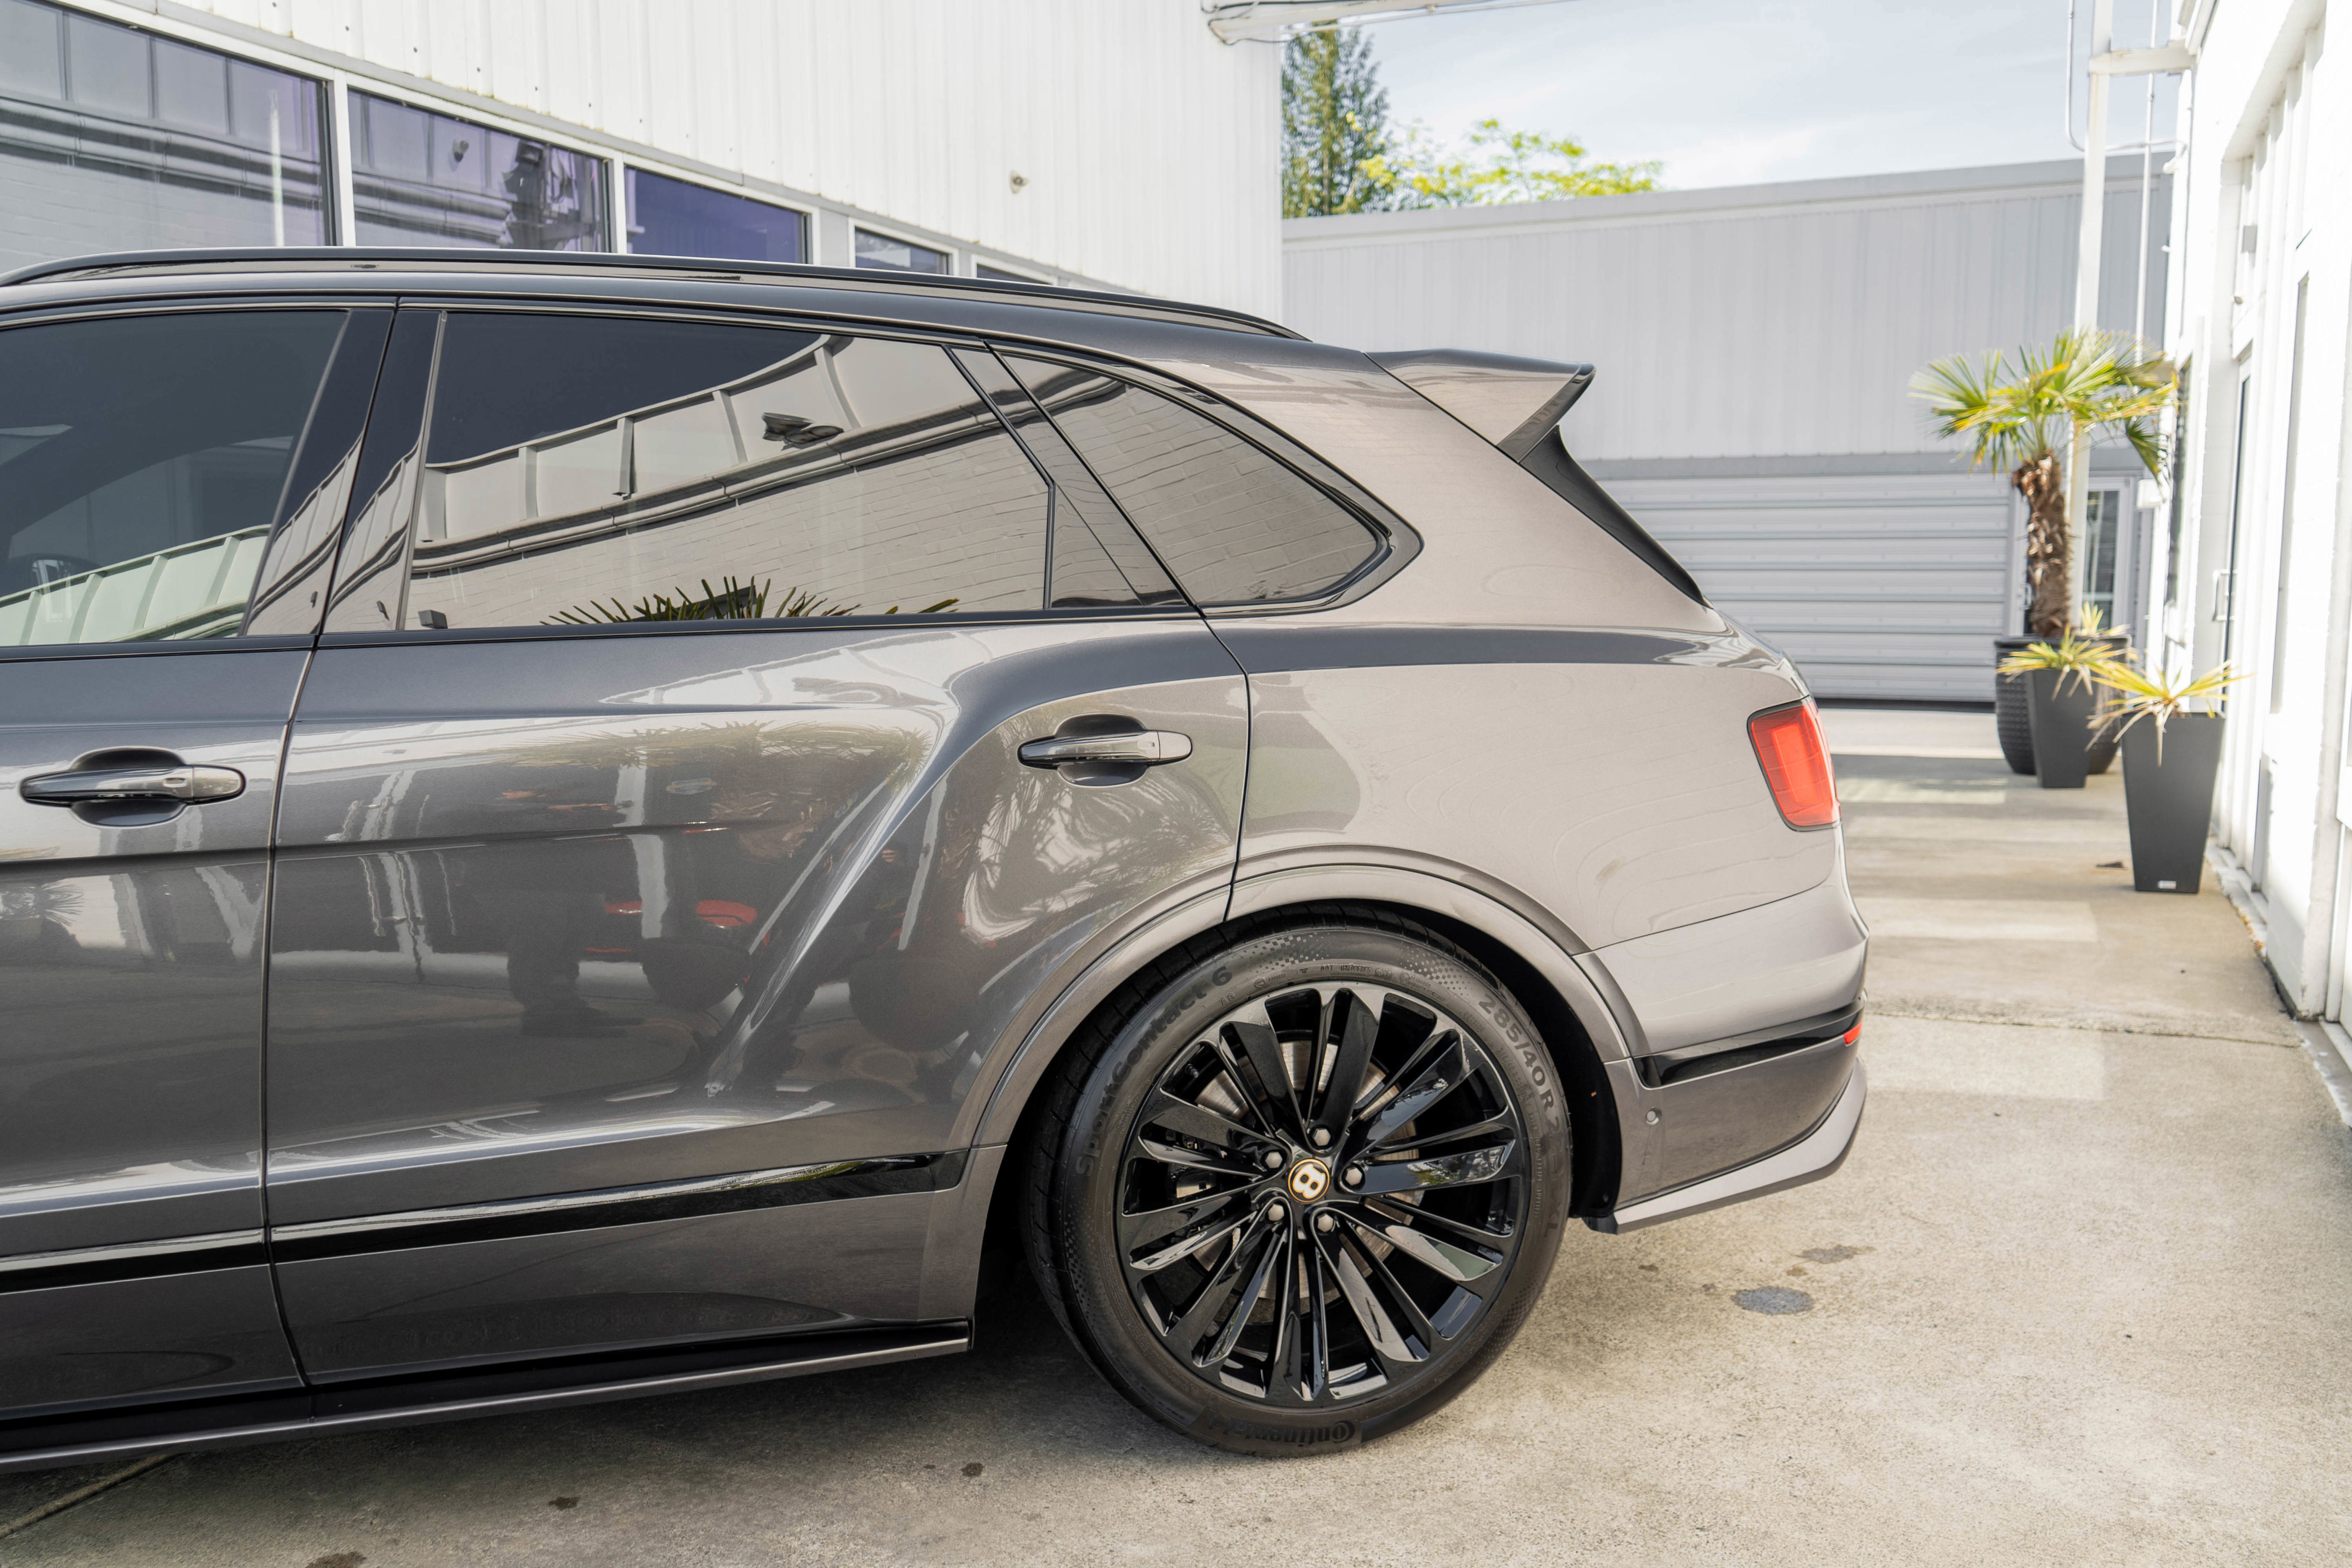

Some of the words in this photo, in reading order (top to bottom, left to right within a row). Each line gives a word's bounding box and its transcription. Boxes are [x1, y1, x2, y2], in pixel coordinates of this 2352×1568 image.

[1075, 985, 1207, 1177] SportContact
[1211, 966, 1232, 986] 6
[1478, 993, 1546, 1086] 285/40
[1292, 1164, 1326, 1199] B
[1222, 1417, 1355, 1447] Continental
